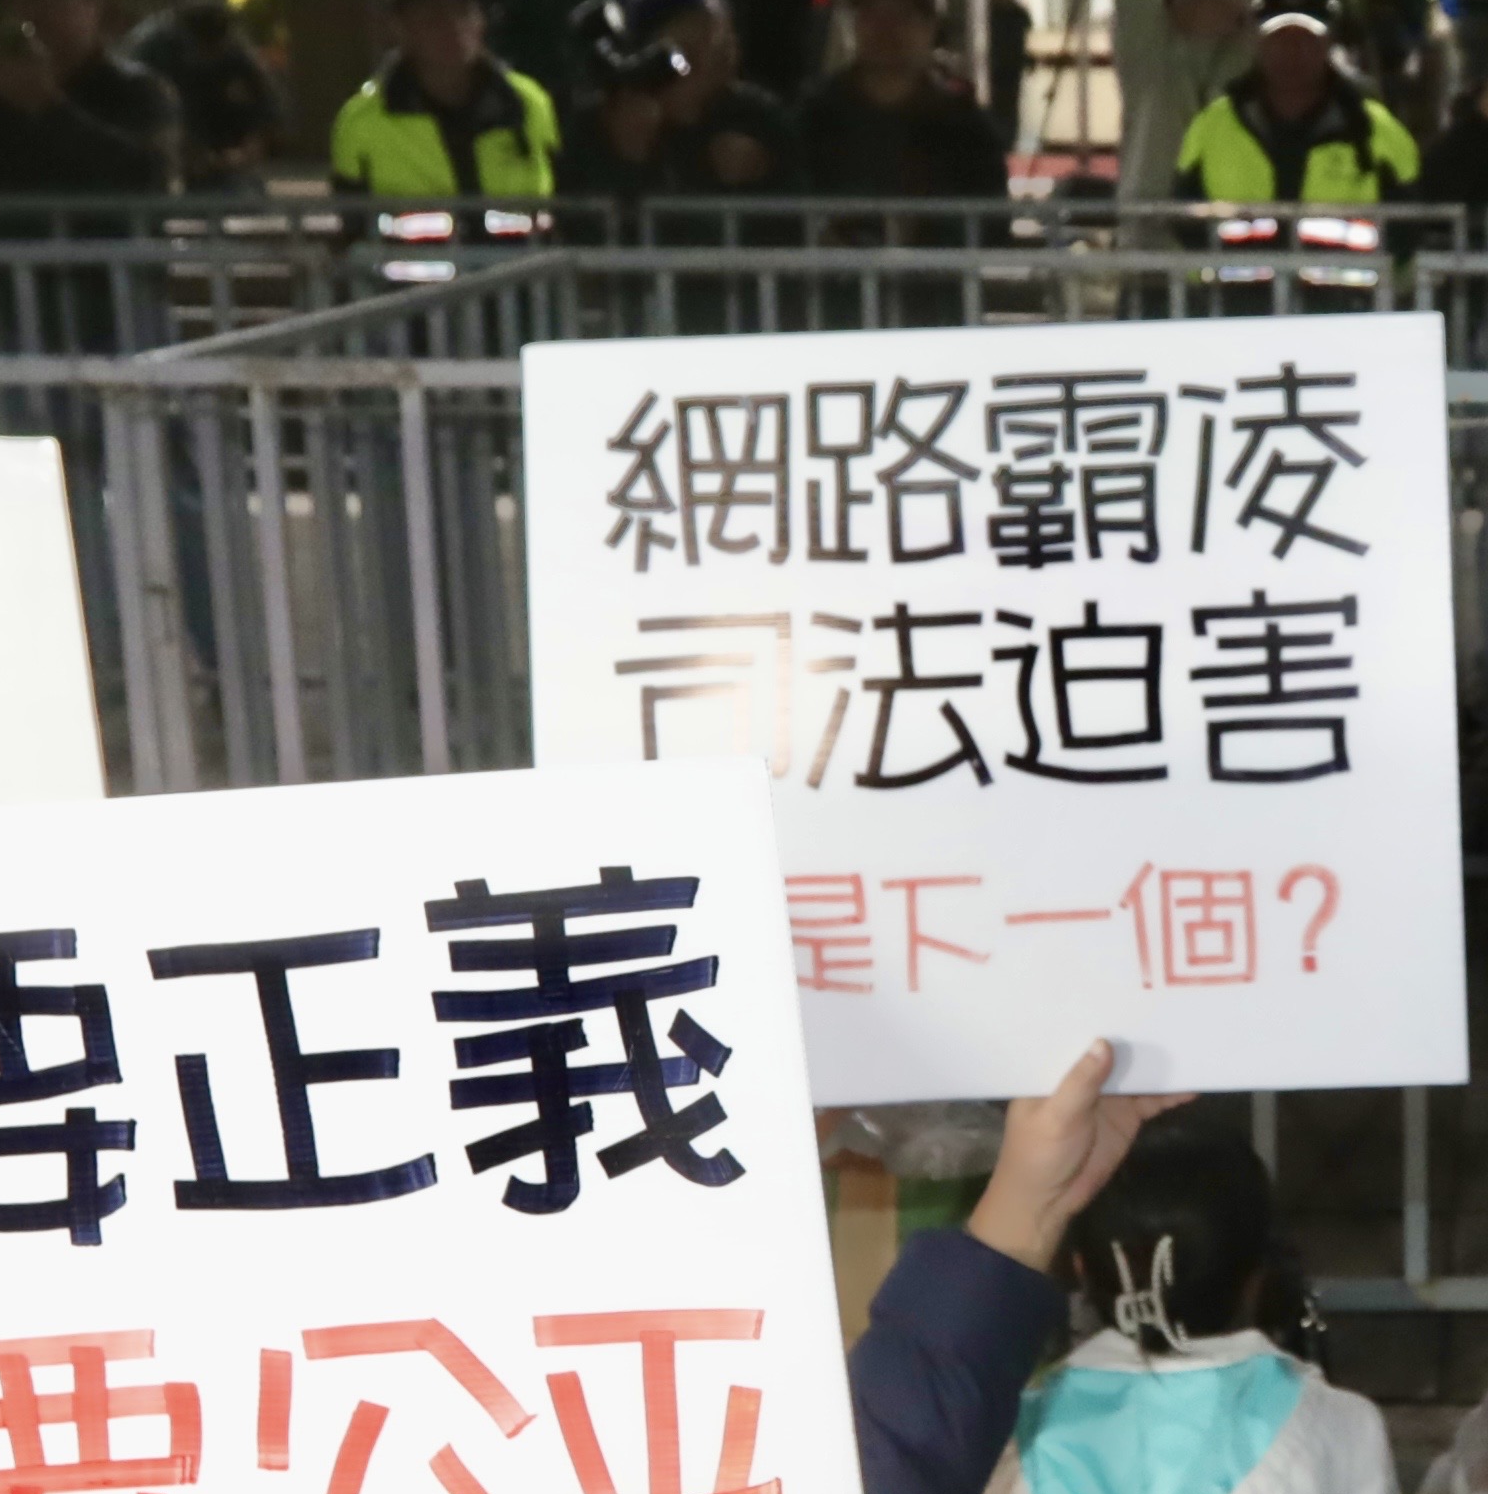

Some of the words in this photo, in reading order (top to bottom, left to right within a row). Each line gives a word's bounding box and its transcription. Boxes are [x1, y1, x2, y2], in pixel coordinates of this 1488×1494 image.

[604, 361, 1372, 573] 網路霸凌
[614, 587, 1362, 791] 司法迫害
